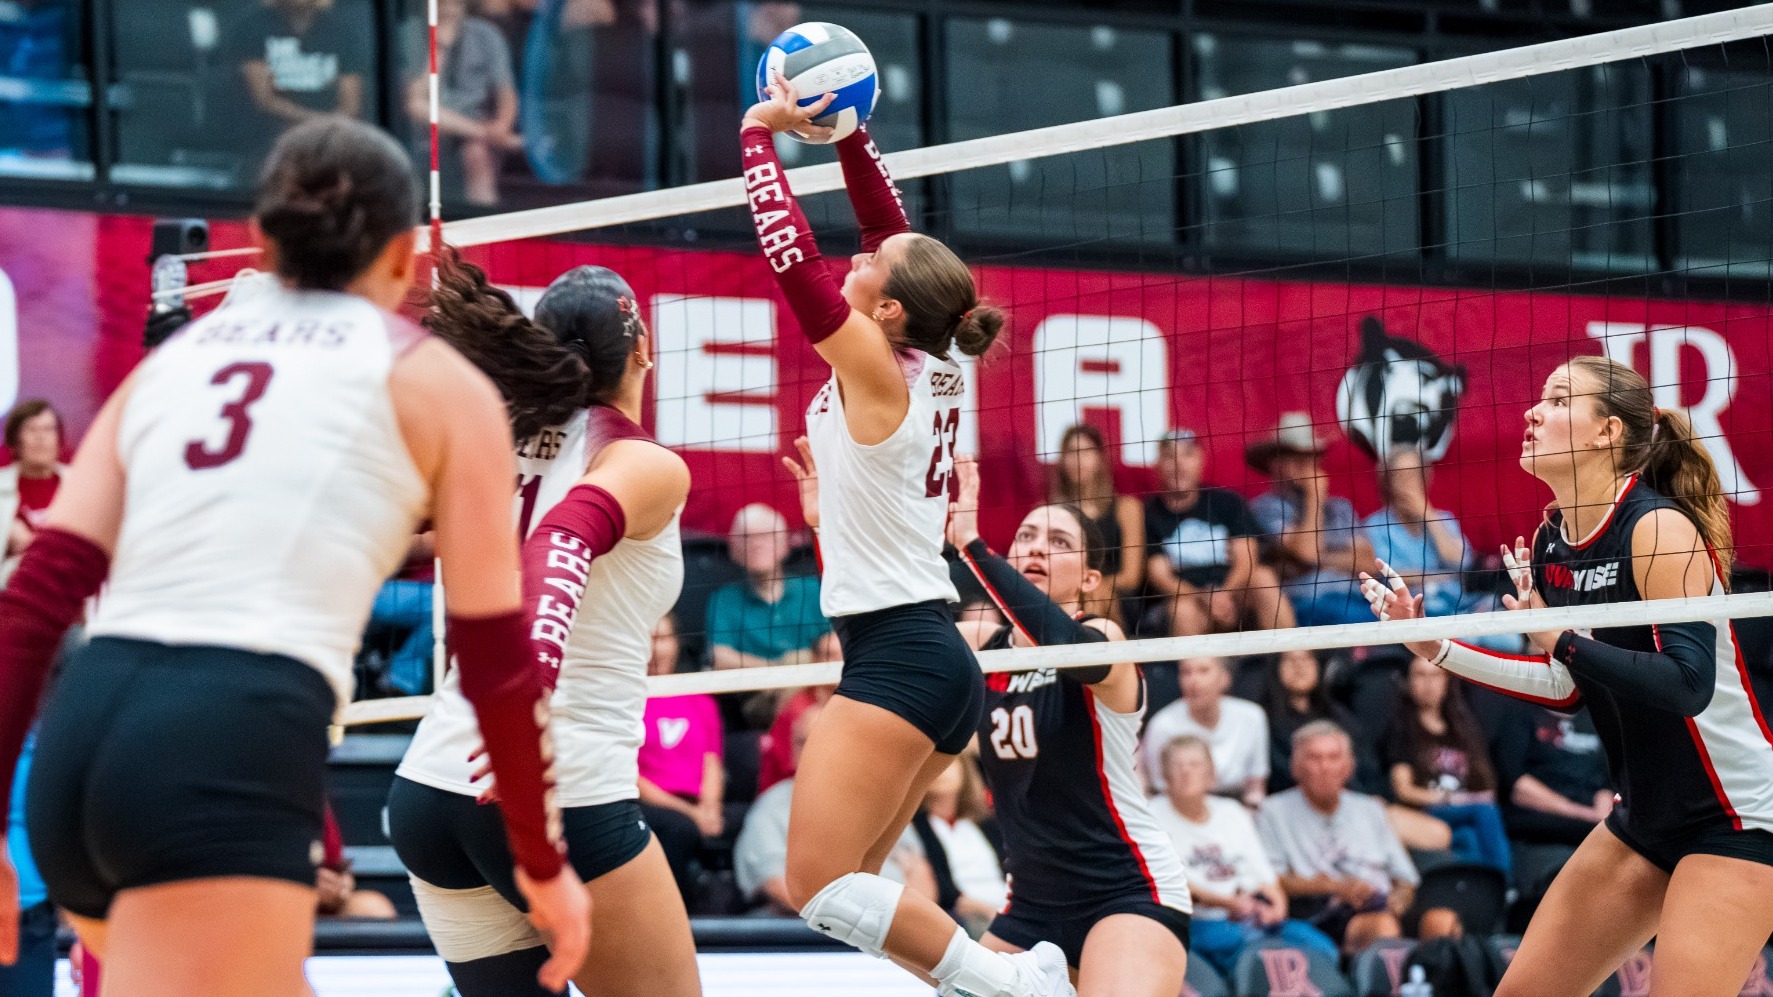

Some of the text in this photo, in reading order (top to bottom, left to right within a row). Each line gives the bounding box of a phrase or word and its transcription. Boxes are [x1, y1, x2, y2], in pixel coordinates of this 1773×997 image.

[743, 161, 804, 274] BEARS
[184, 360, 275, 471] 3
[925, 407, 961, 503] 23
[990, 704, 1039, 759] 20
